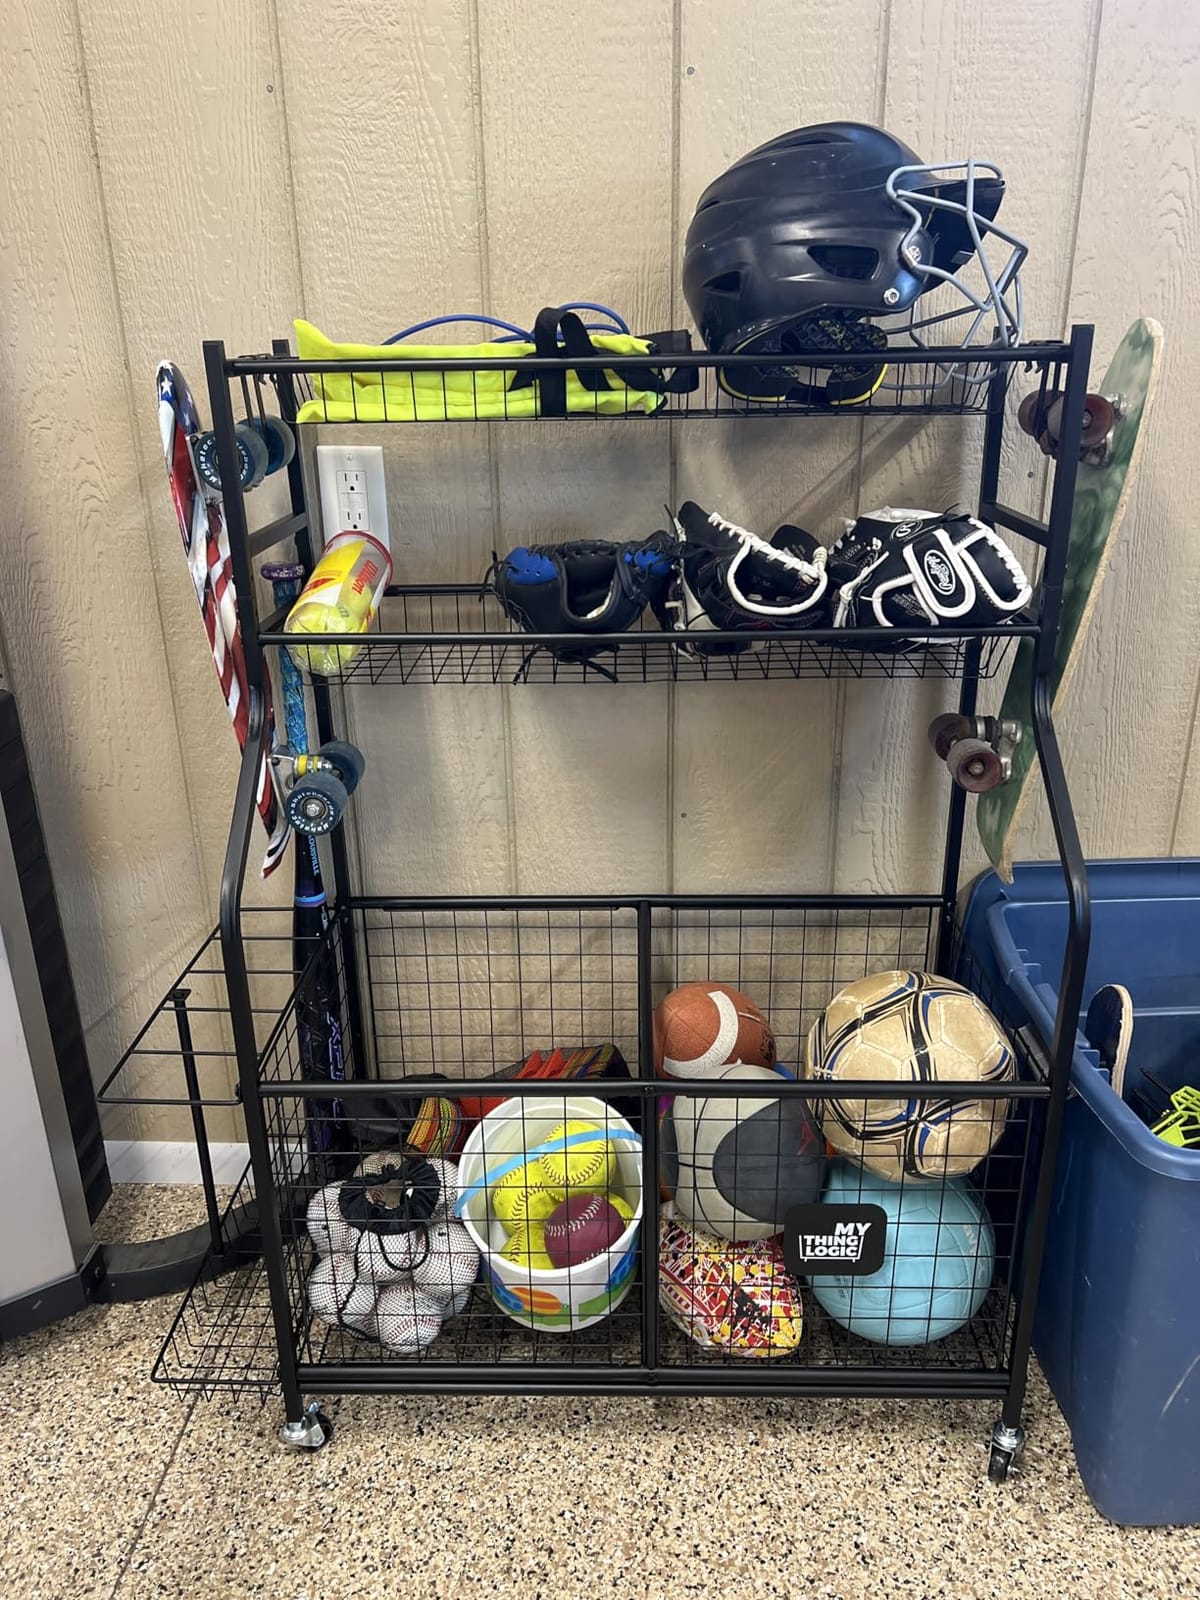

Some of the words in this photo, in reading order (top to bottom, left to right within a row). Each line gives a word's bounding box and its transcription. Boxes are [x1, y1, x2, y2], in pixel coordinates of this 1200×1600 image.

[352, 559, 378, 595] Wilson
[834, 1222, 872, 1236] MY
[803, 1235, 859, 1246] THING
[805, 1246, 858, 1257] LOGIC
